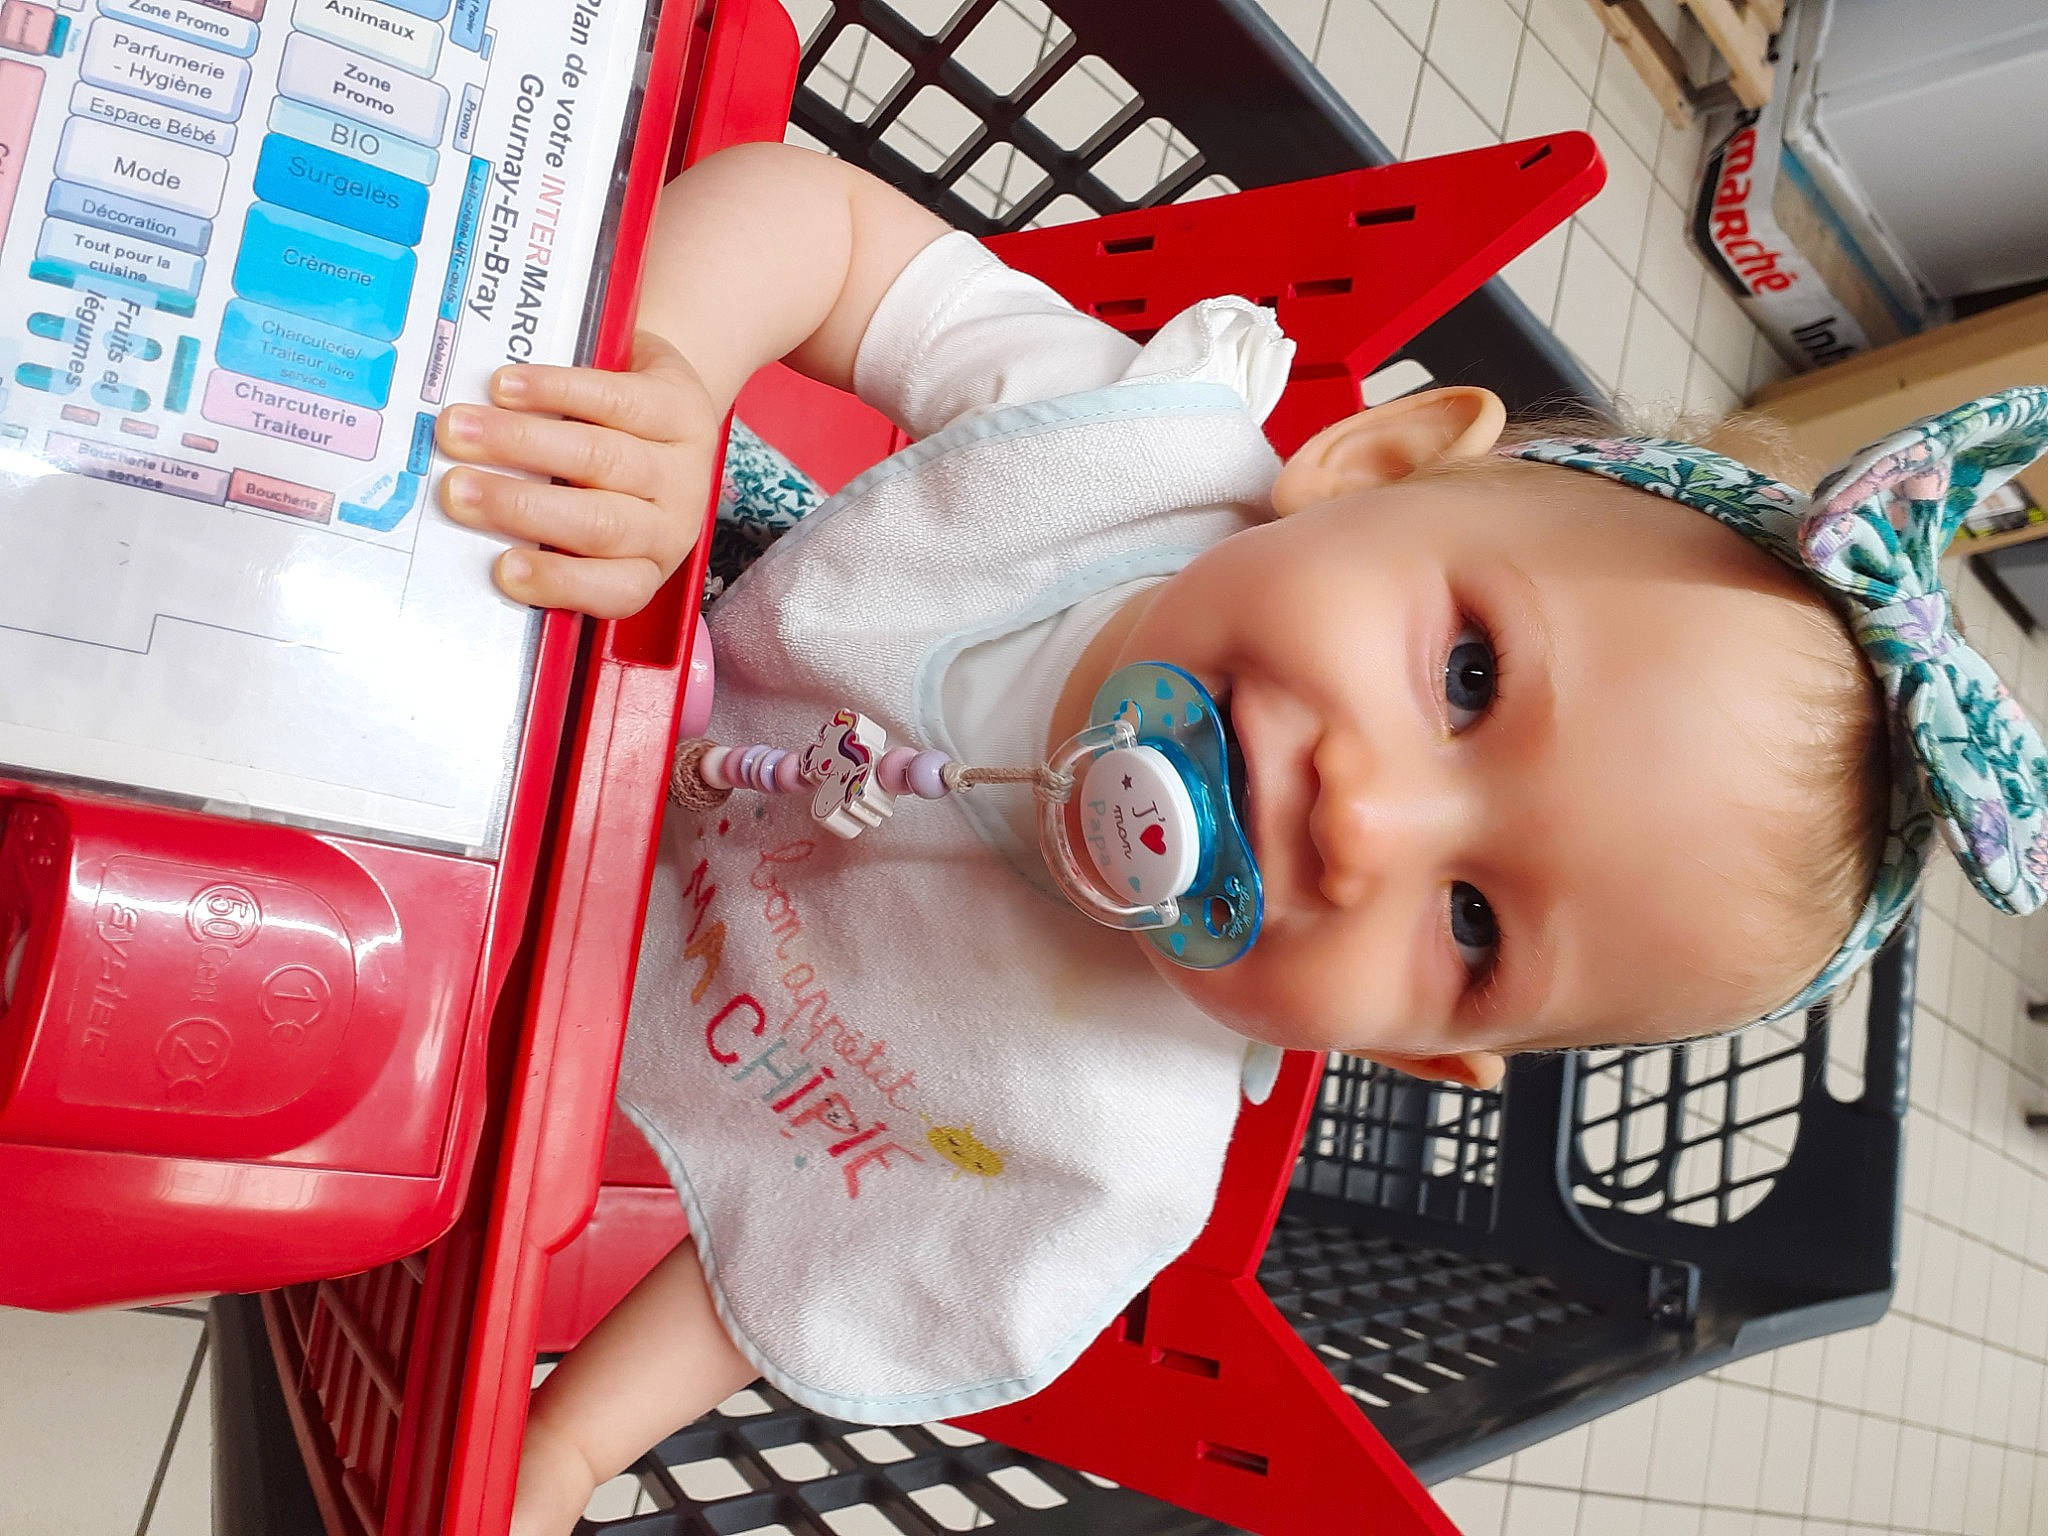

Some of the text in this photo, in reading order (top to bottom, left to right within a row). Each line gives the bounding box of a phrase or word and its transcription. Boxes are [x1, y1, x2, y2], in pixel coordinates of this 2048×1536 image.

[176, 10, 230, 37] Promo
[324, 0, 414, 41] Animaux
[112, 34, 225, 81] Parfumerie
[343, 62, 391, 93] Zone
[562, 52, 588, 89] de
[128, 64, 213, 101] Hygiène
[332, 81, 395, 117] Promo
[89, 97, 217, 146] Espace Bébé
[330, 121, 380, 156] BIO
[460, 99, 477, 140] Promo
[543, 95, 575, 170] votre
[113, 156, 182, 190] Mode
[81, 198, 177, 238] Décoration
[468, 73, 545, 322] Gournay-En-Bray
[73, 233, 172, 270] Tout pour la
[88, 259, 149, 284] cuisine
[283, 247, 374, 288] Crèmerie
[64, 289, 108, 388] légumes
[106, 297, 142, 364] Fruits
[260, 339, 355, 381] Traiteur libre
[233, 381, 358, 429] Charcuterie
[252, 410, 333, 448] Traiteur
[159, 458, 200, 483] Libre
[244, 482, 319, 512] Boucherie
[1087, 799, 1111, 868] Papa
[1112, 804, 1133, 860] mon
[199, 895, 250, 941] 50
[749, 839, 919, 1113] bon appétit
[682, 858, 926, 1201] MA CHIPIE
